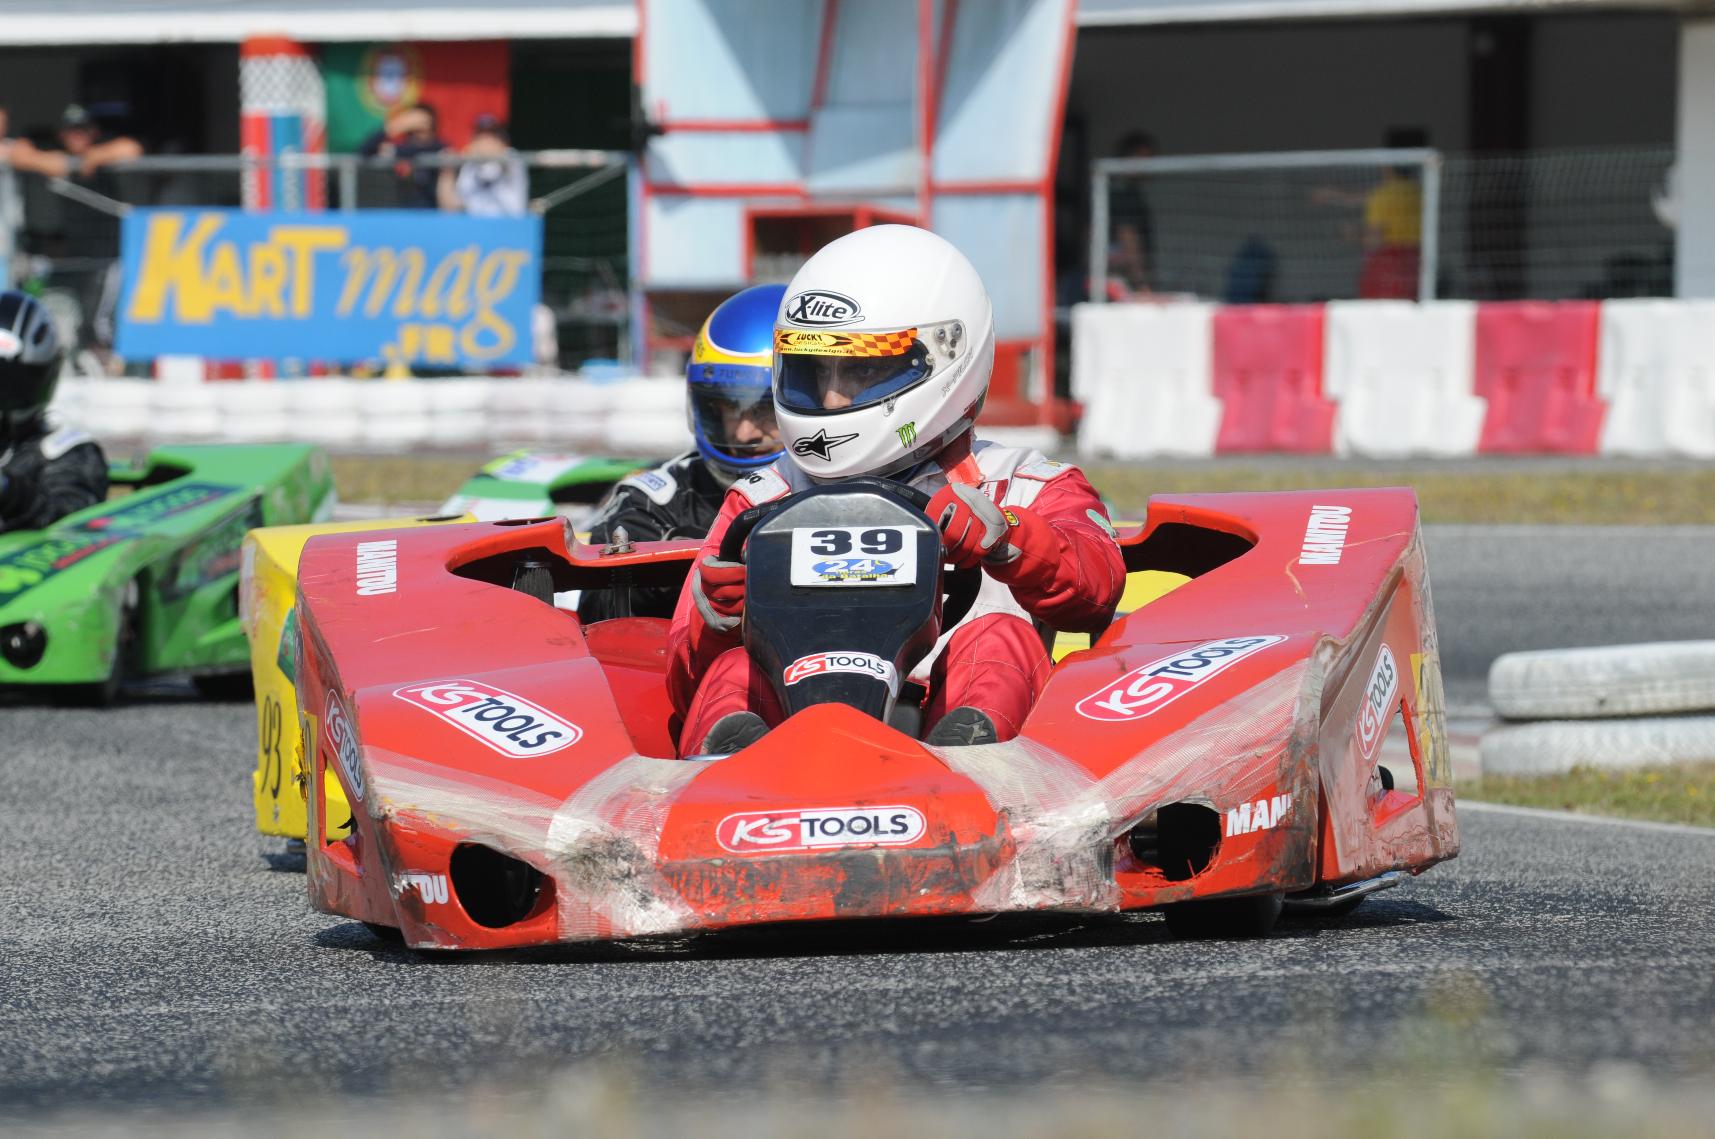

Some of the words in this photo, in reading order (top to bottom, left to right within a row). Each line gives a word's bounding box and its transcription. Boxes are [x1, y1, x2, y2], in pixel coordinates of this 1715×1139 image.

[335, 246, 530, 360] mag
[791, 296, 848, 319] X-lite
[796, 333, 823, 342] LUCKY
[810, 529, 903, 556] 39
[1299, 505, 1353, 565] MANITOU
[356, 539, 398, 596] MANITOU
[824, 559, 876, 573] 24
[789, 658, 827, 681] KS
[826, 656, 885, 675] TOOLS
[1094, 674, 1174, 716] KS
[1148, 638, 1267, 676] TOOLS
[327, 699, 345, 743] KS
[406, 683, 494, 705] KS
[461, 697, 563, 749] TOOLS
[1358, 699, 1376, 752] KS
[1369, 654, 1394, 716] TOOLS
[261, 694, 282, 800] 93
[731, 817, 801, 847] KS
[800, 814, 910, 838] TOOLS
